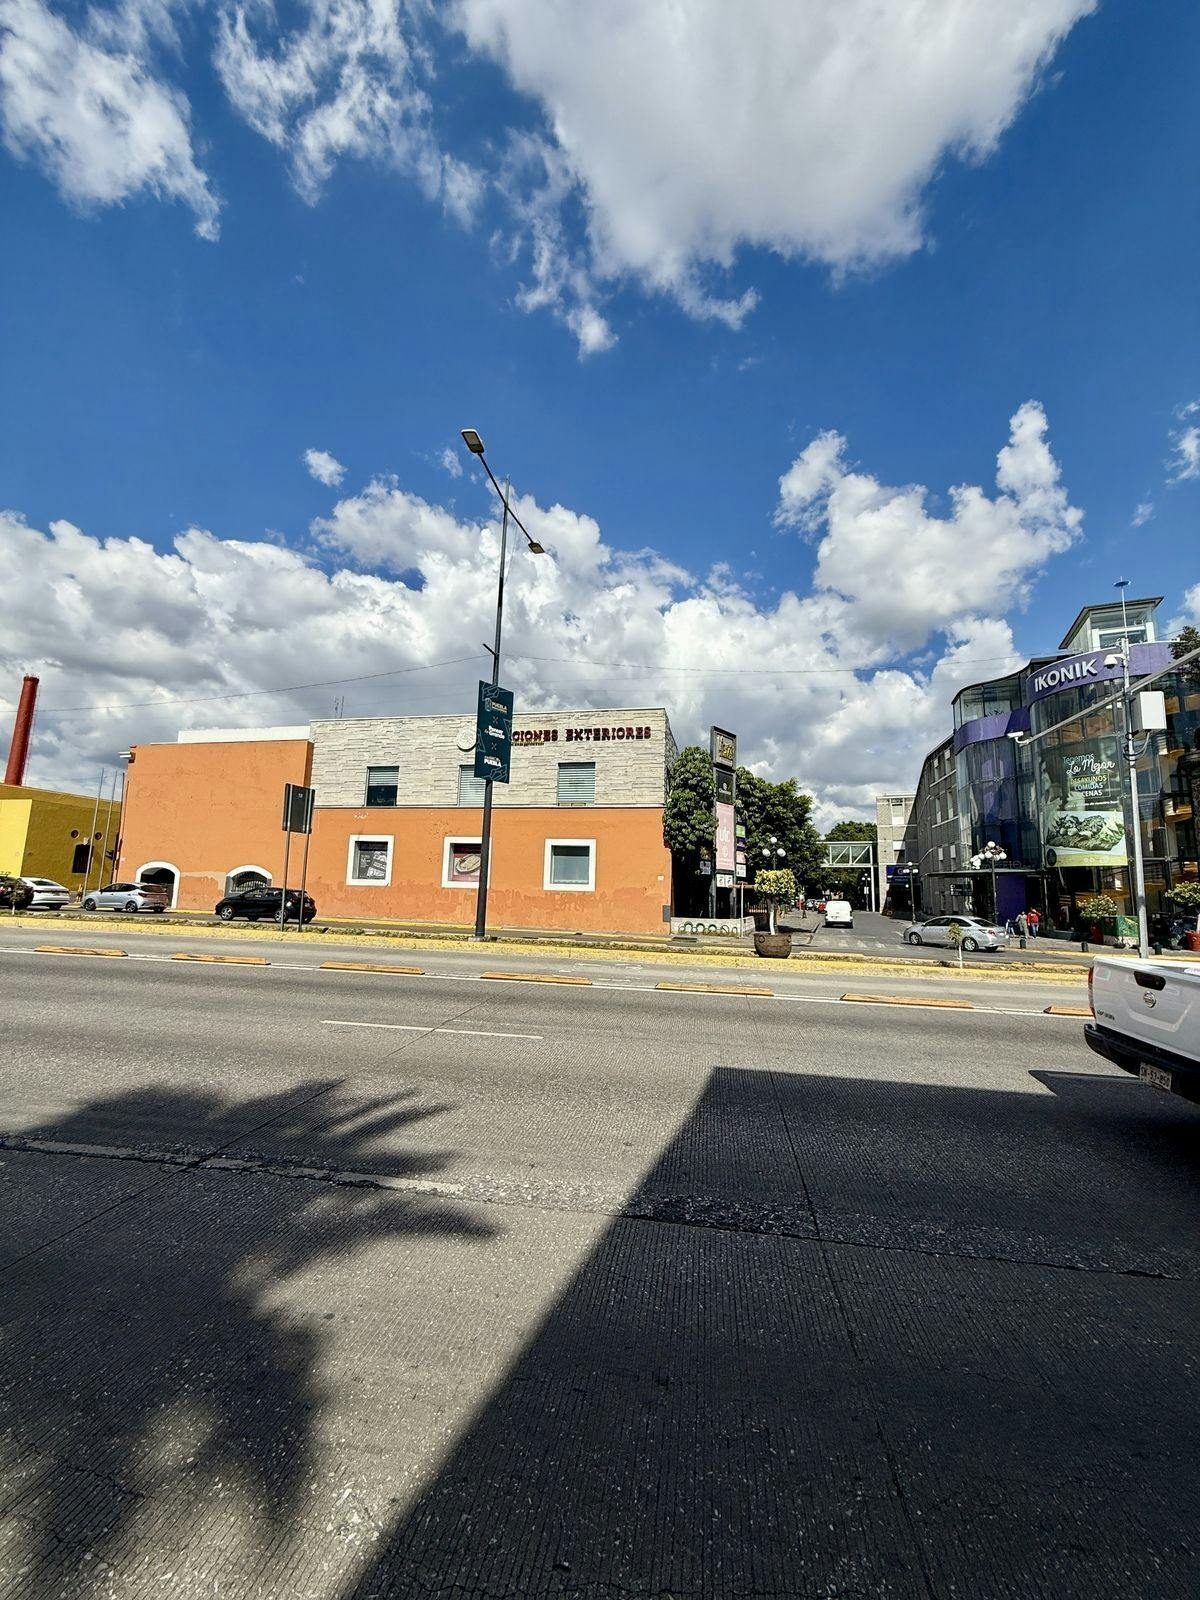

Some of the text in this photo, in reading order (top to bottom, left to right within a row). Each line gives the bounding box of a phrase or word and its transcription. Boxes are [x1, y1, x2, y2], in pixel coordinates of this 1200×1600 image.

[1034, 658, 1098, 692] IKONIK
[564, 726, 652, 742] EXTERIORES
[1081, 759, 1116, 774] Mejor
[1070, 774, 1107, 785] DESAYUNOS
[1074, 782, 1103, 791] COMIDAS
